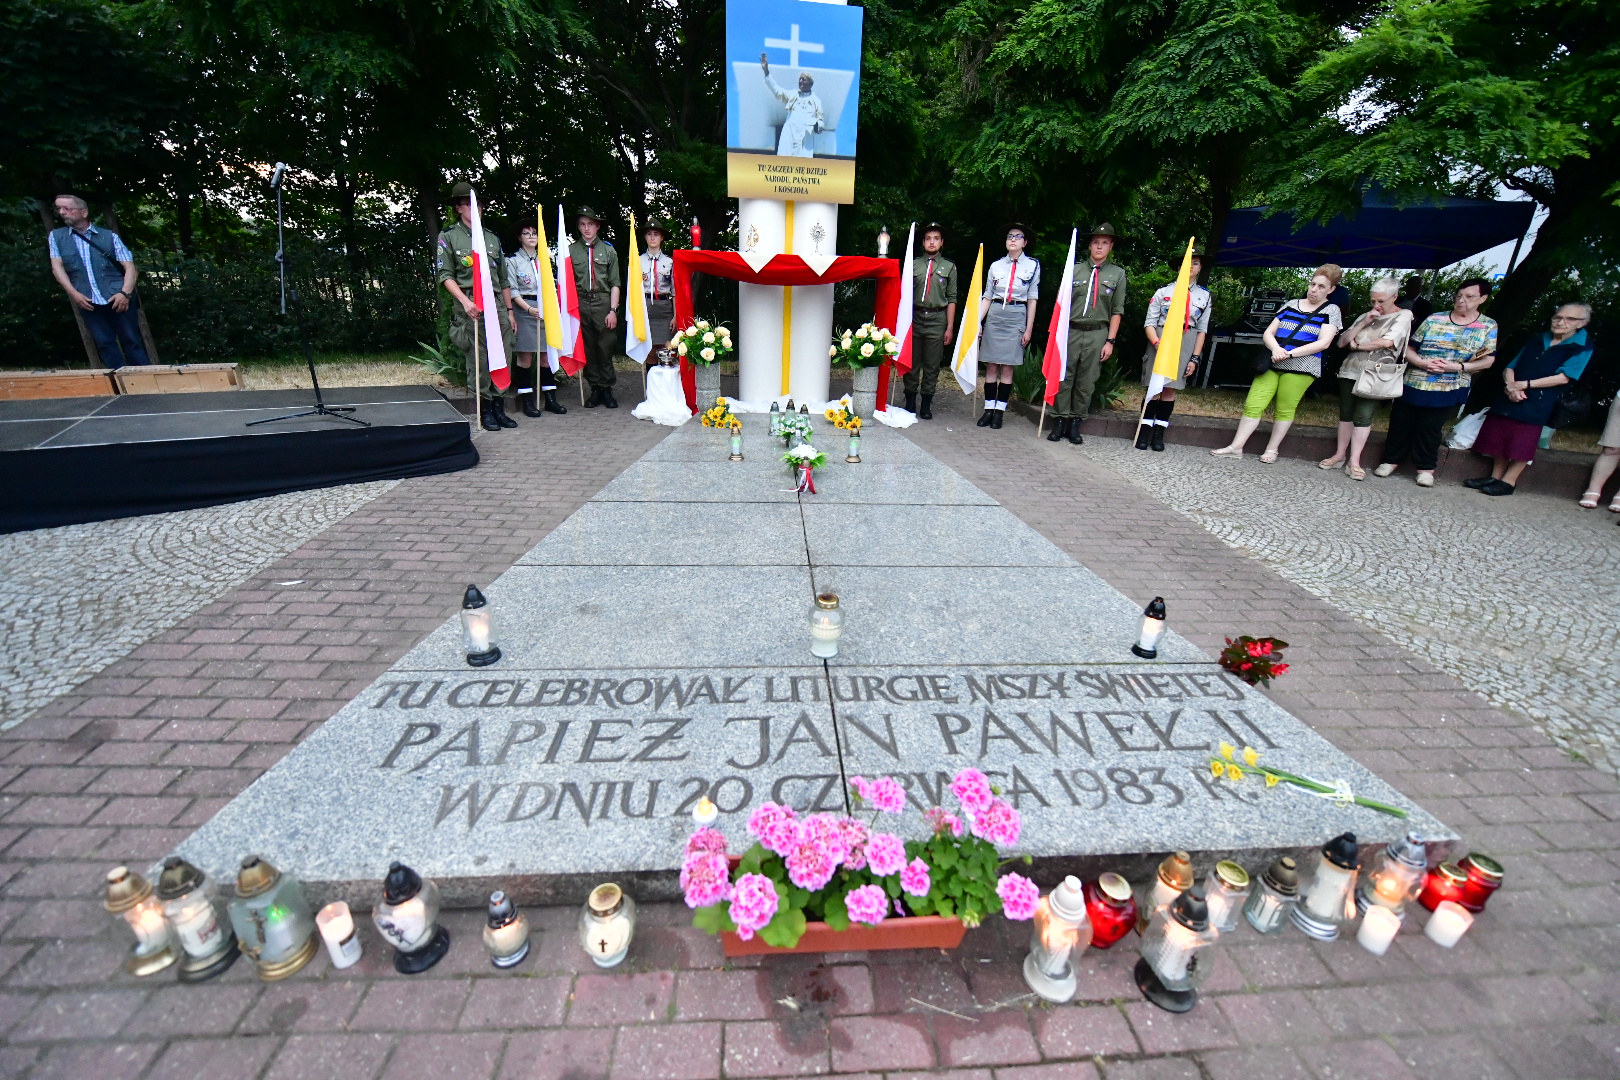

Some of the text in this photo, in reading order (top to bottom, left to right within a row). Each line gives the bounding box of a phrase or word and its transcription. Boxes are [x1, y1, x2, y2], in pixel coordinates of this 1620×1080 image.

[758, 164, 766, 172] TU
[794, 167, 806, 175] SIĘ
[806, 167, 828, 176] DZIEJE
[792, 176, 820, 185] PAŃSTWA
[368, 681, 446, 709] TU
[447, 674, 755, 711] CELEBROWAŁ
[961, 672, 1072, 705] MSZY
[374, 706, 1282, 774] PAPIEŻ JAN PAWEŁ II
[433, 763, 1259, 830] W DNIU 20 CZRWA 1983 R.
